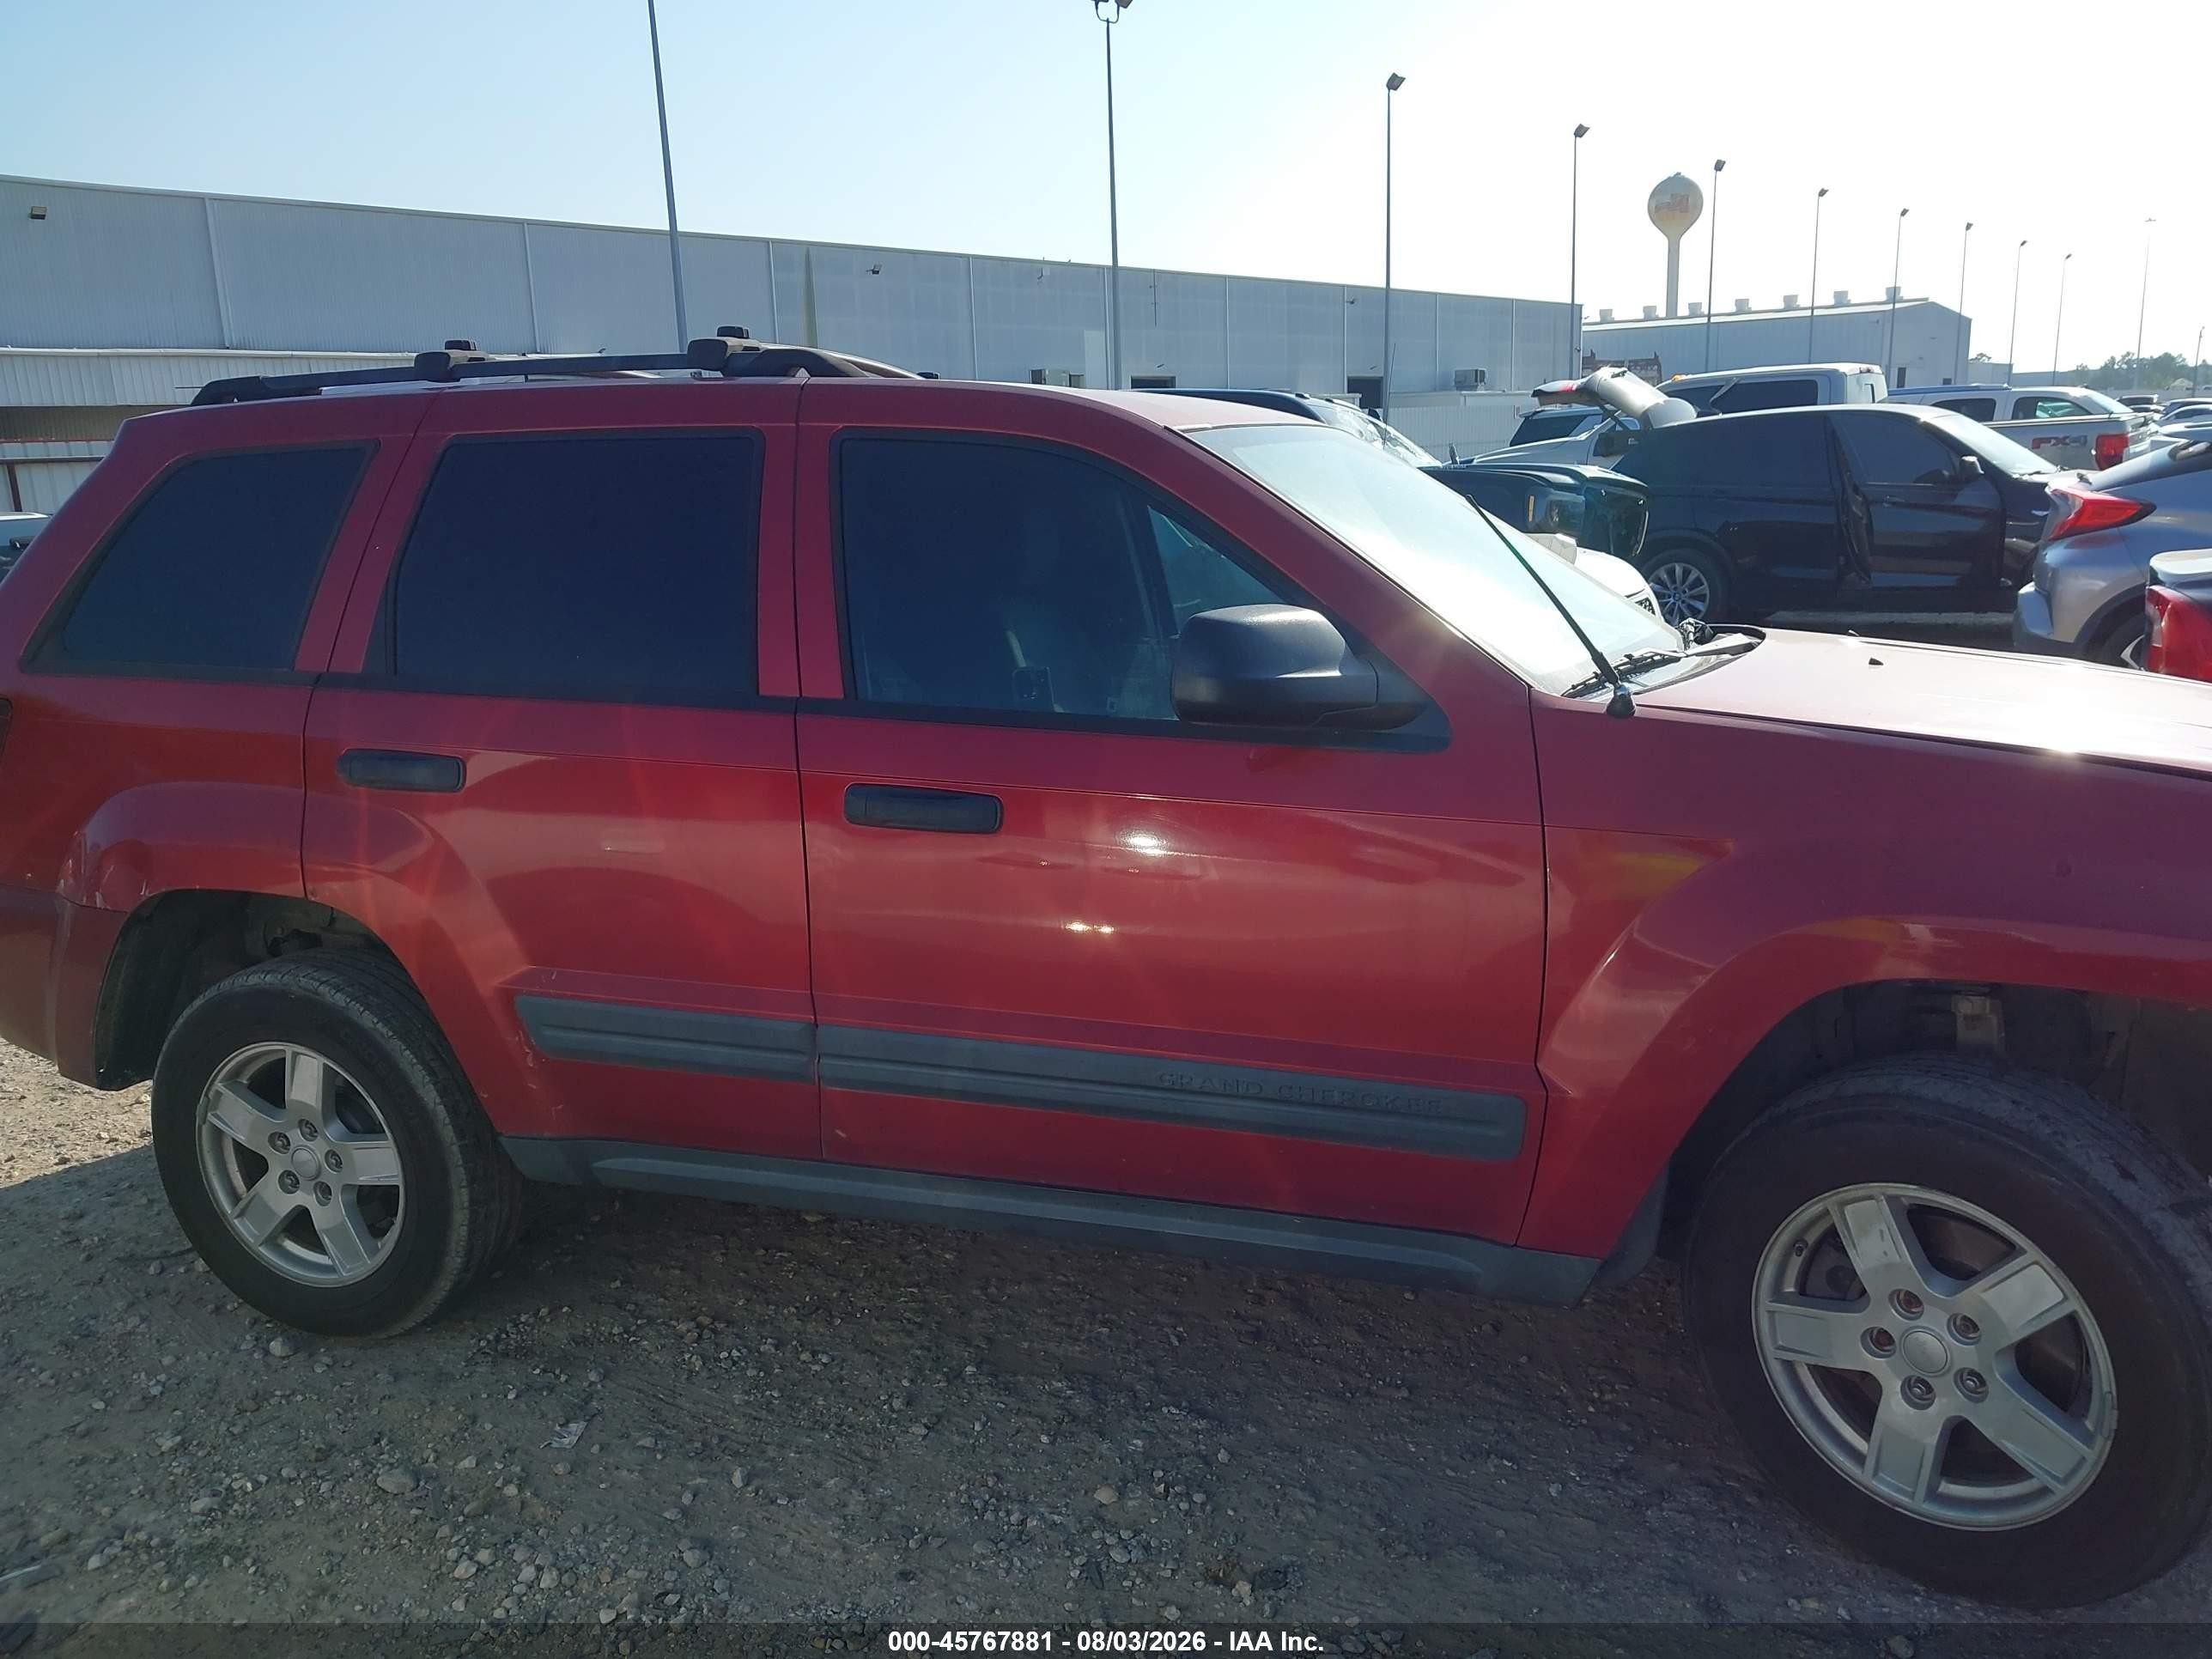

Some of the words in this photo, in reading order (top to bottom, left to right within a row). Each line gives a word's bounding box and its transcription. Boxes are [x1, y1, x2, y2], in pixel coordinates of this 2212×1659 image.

[2031, 434, 2088, 450] FX4
[1156, 1071, 1264, 1096] GRAND
[1278, 1085, 1443, 1114] CHEROKEE
